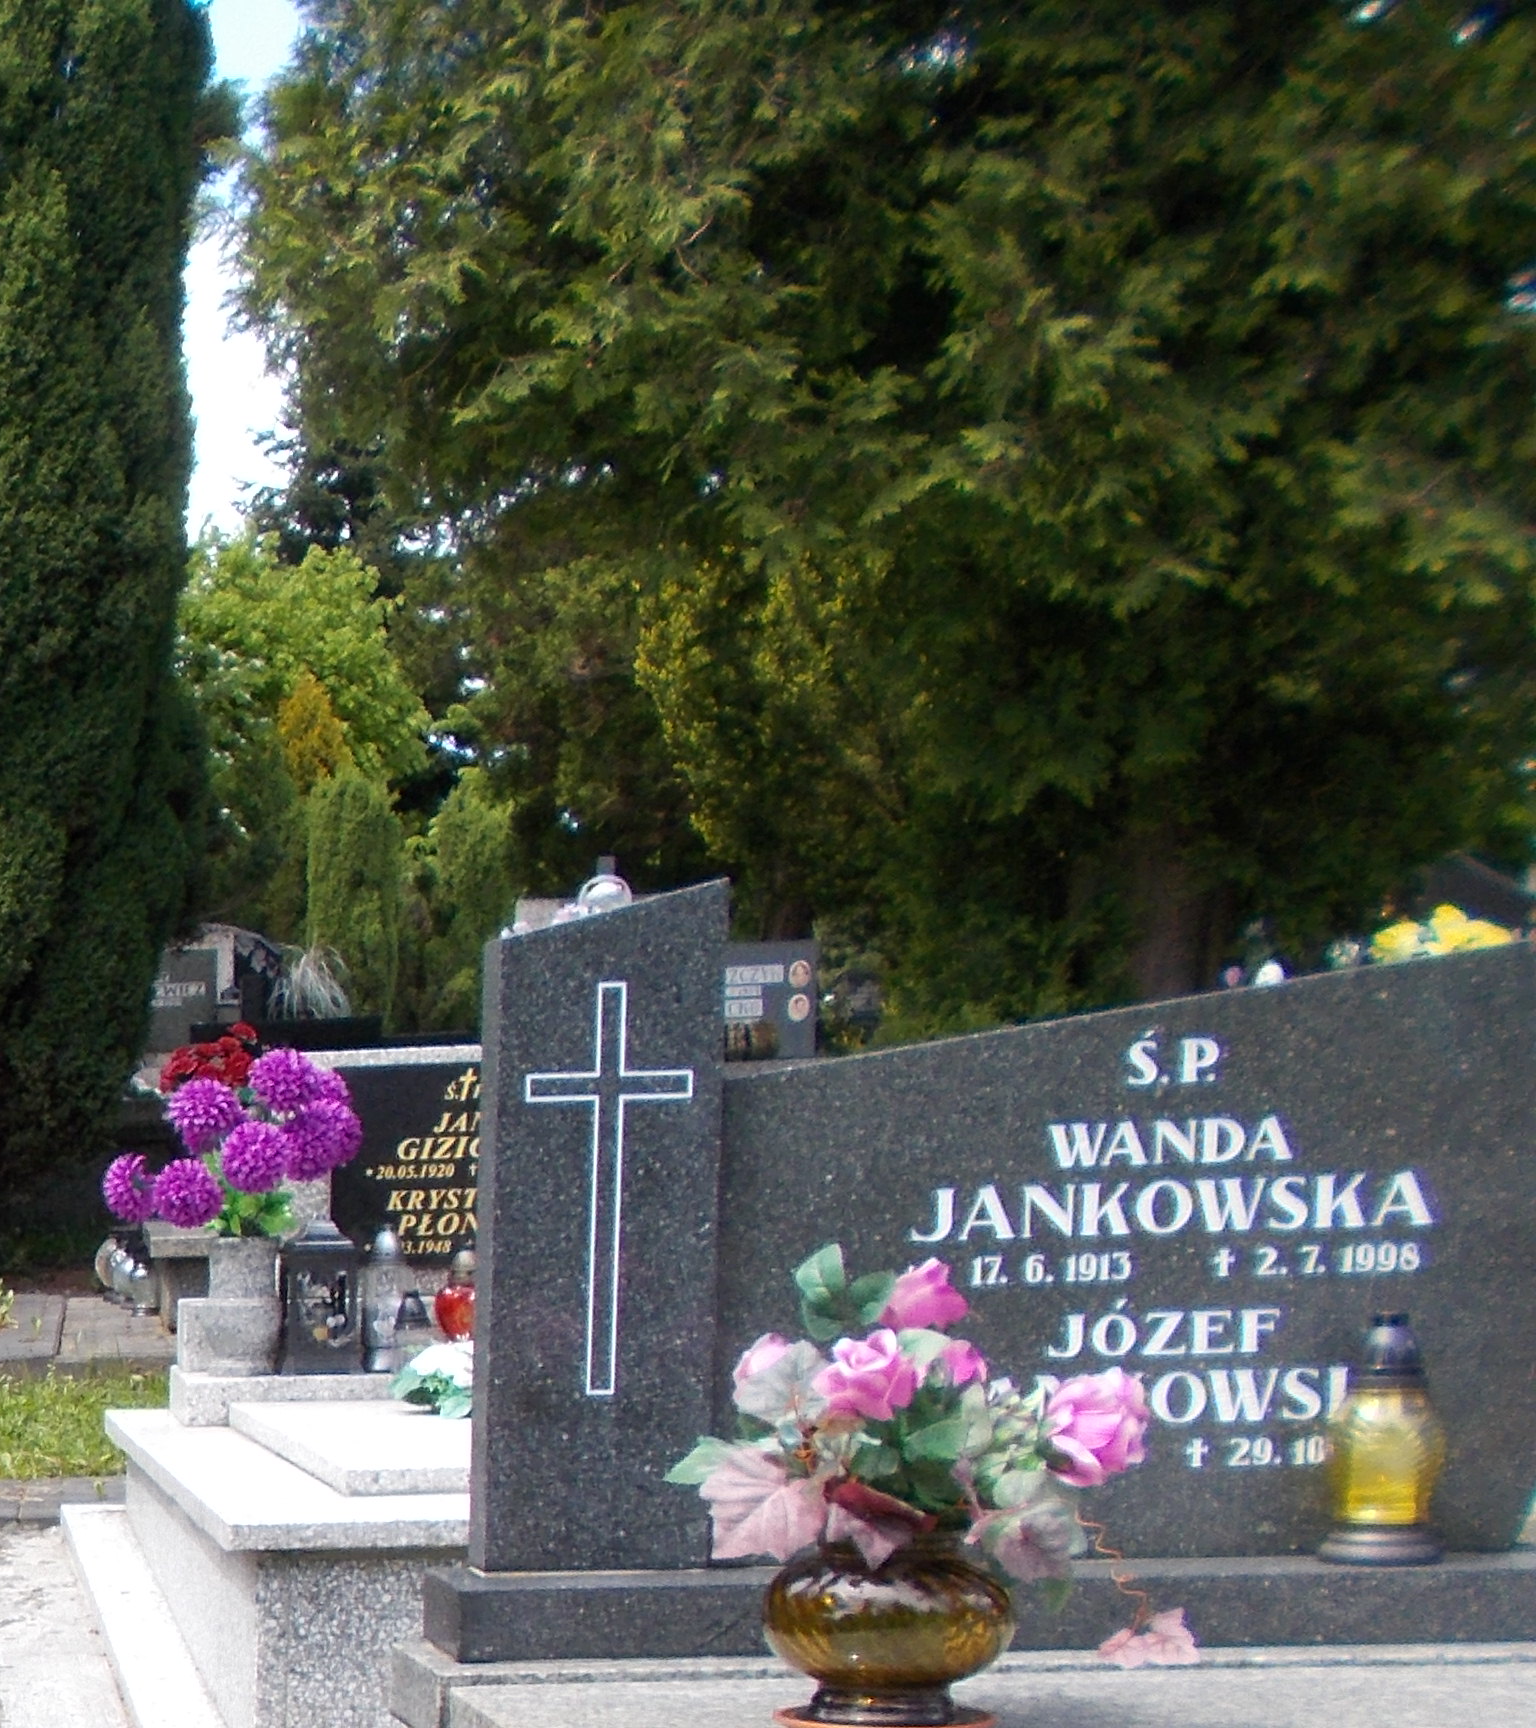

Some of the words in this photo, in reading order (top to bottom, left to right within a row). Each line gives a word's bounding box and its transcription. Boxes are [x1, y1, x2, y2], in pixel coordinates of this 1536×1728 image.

[1046, 1114, 1294, 1170] WANDA
[907, 1169, 1435, 1244] JANKOWSKA
[1064, 1250, 1132, 1283] 1913
[1337, 1243, 1422, 1276] 1998
[1047, 1299, 1282, 1359] JÓZEF
